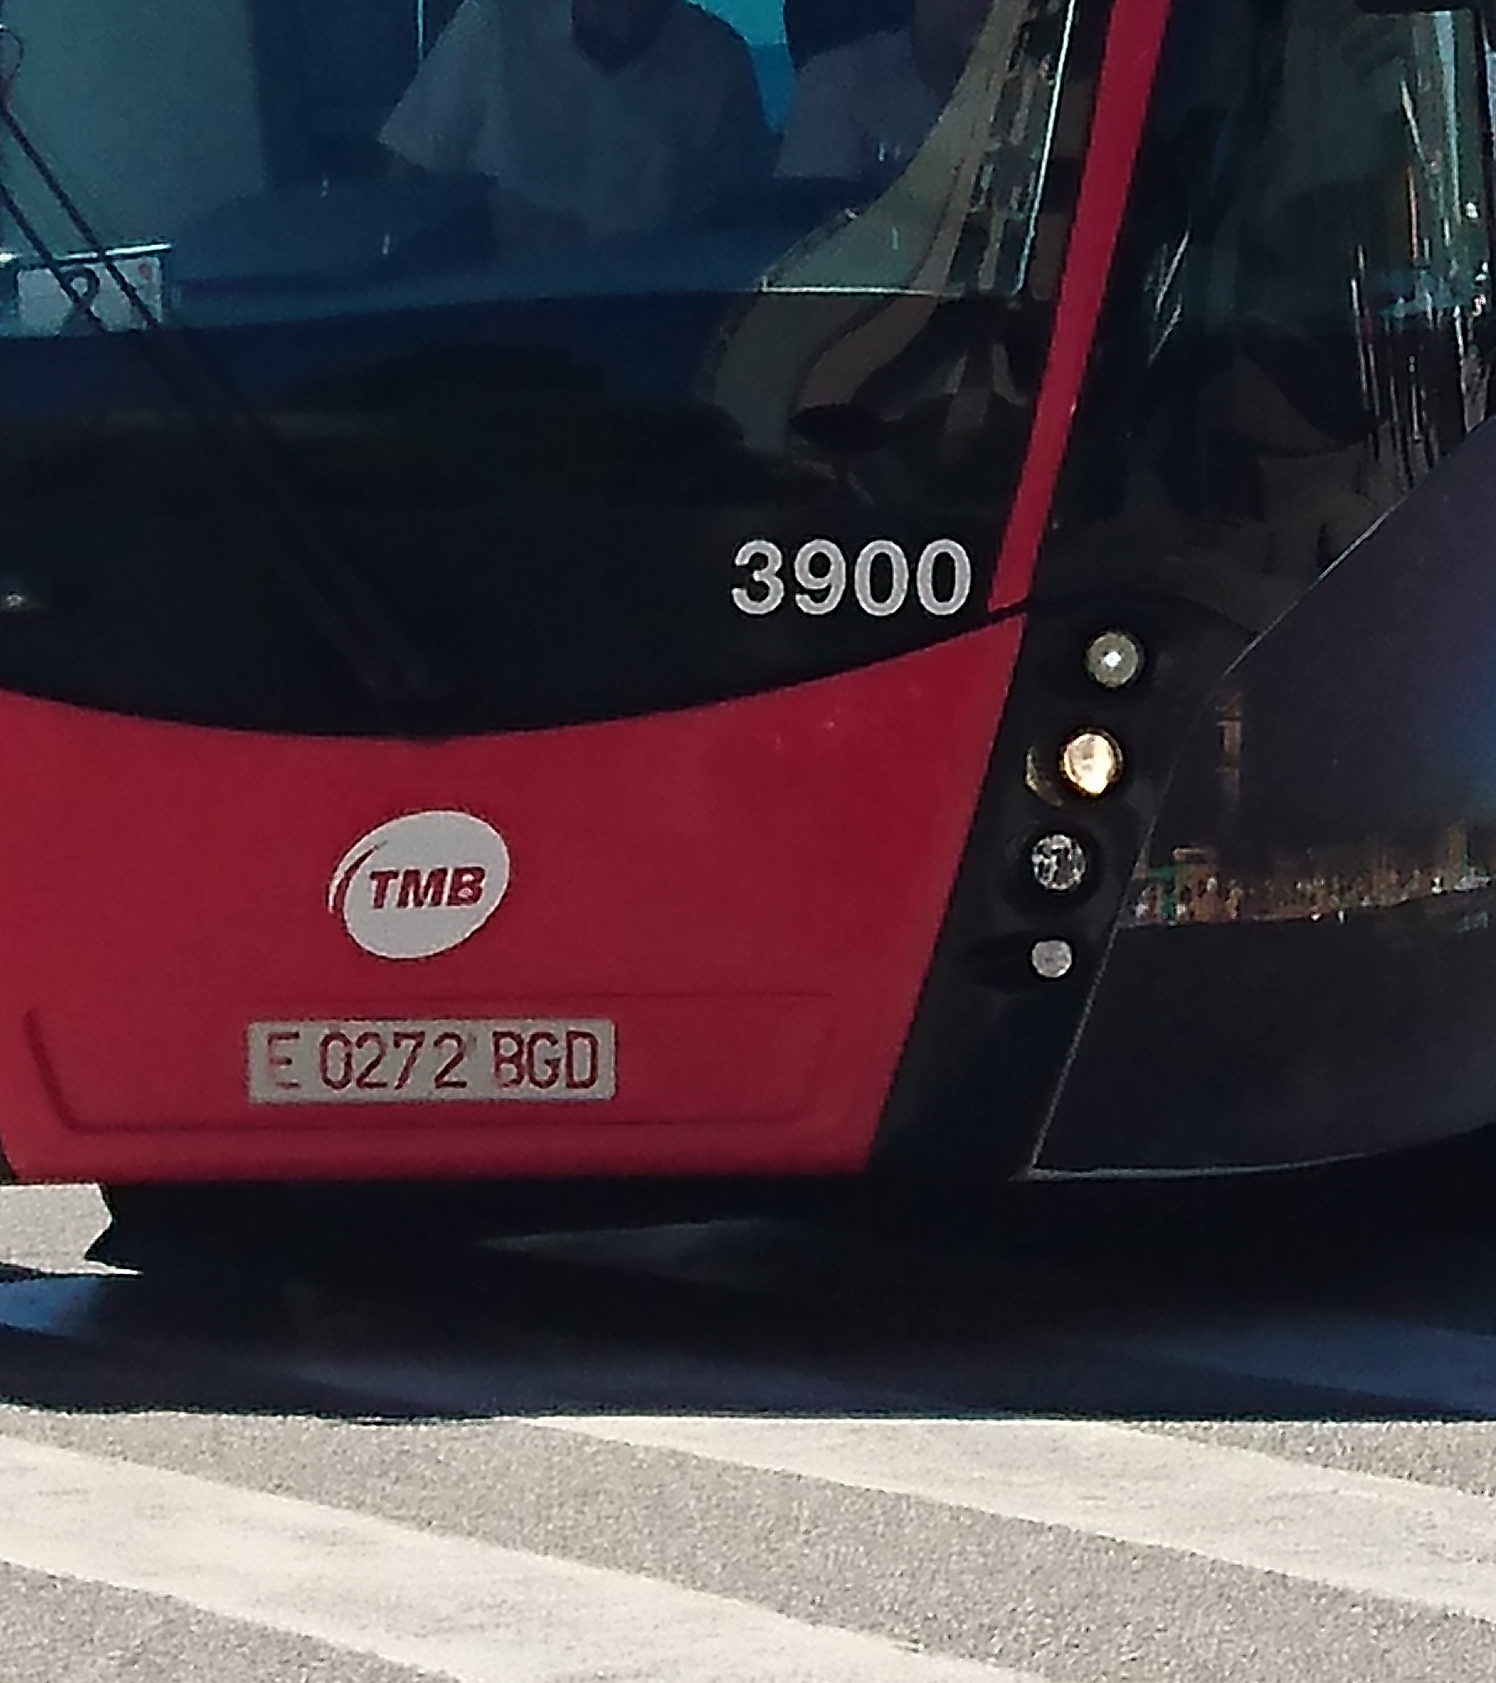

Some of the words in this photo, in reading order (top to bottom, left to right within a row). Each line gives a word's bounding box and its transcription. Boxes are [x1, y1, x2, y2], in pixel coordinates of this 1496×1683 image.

[730, 538, 972, 616] 3900
[368, 865, 487, 911] TMB
[266, 1030, 302, 1091] E
[318, 1029, 469, 1091] 0272
[491, 1029, 600, 1091] BGD
